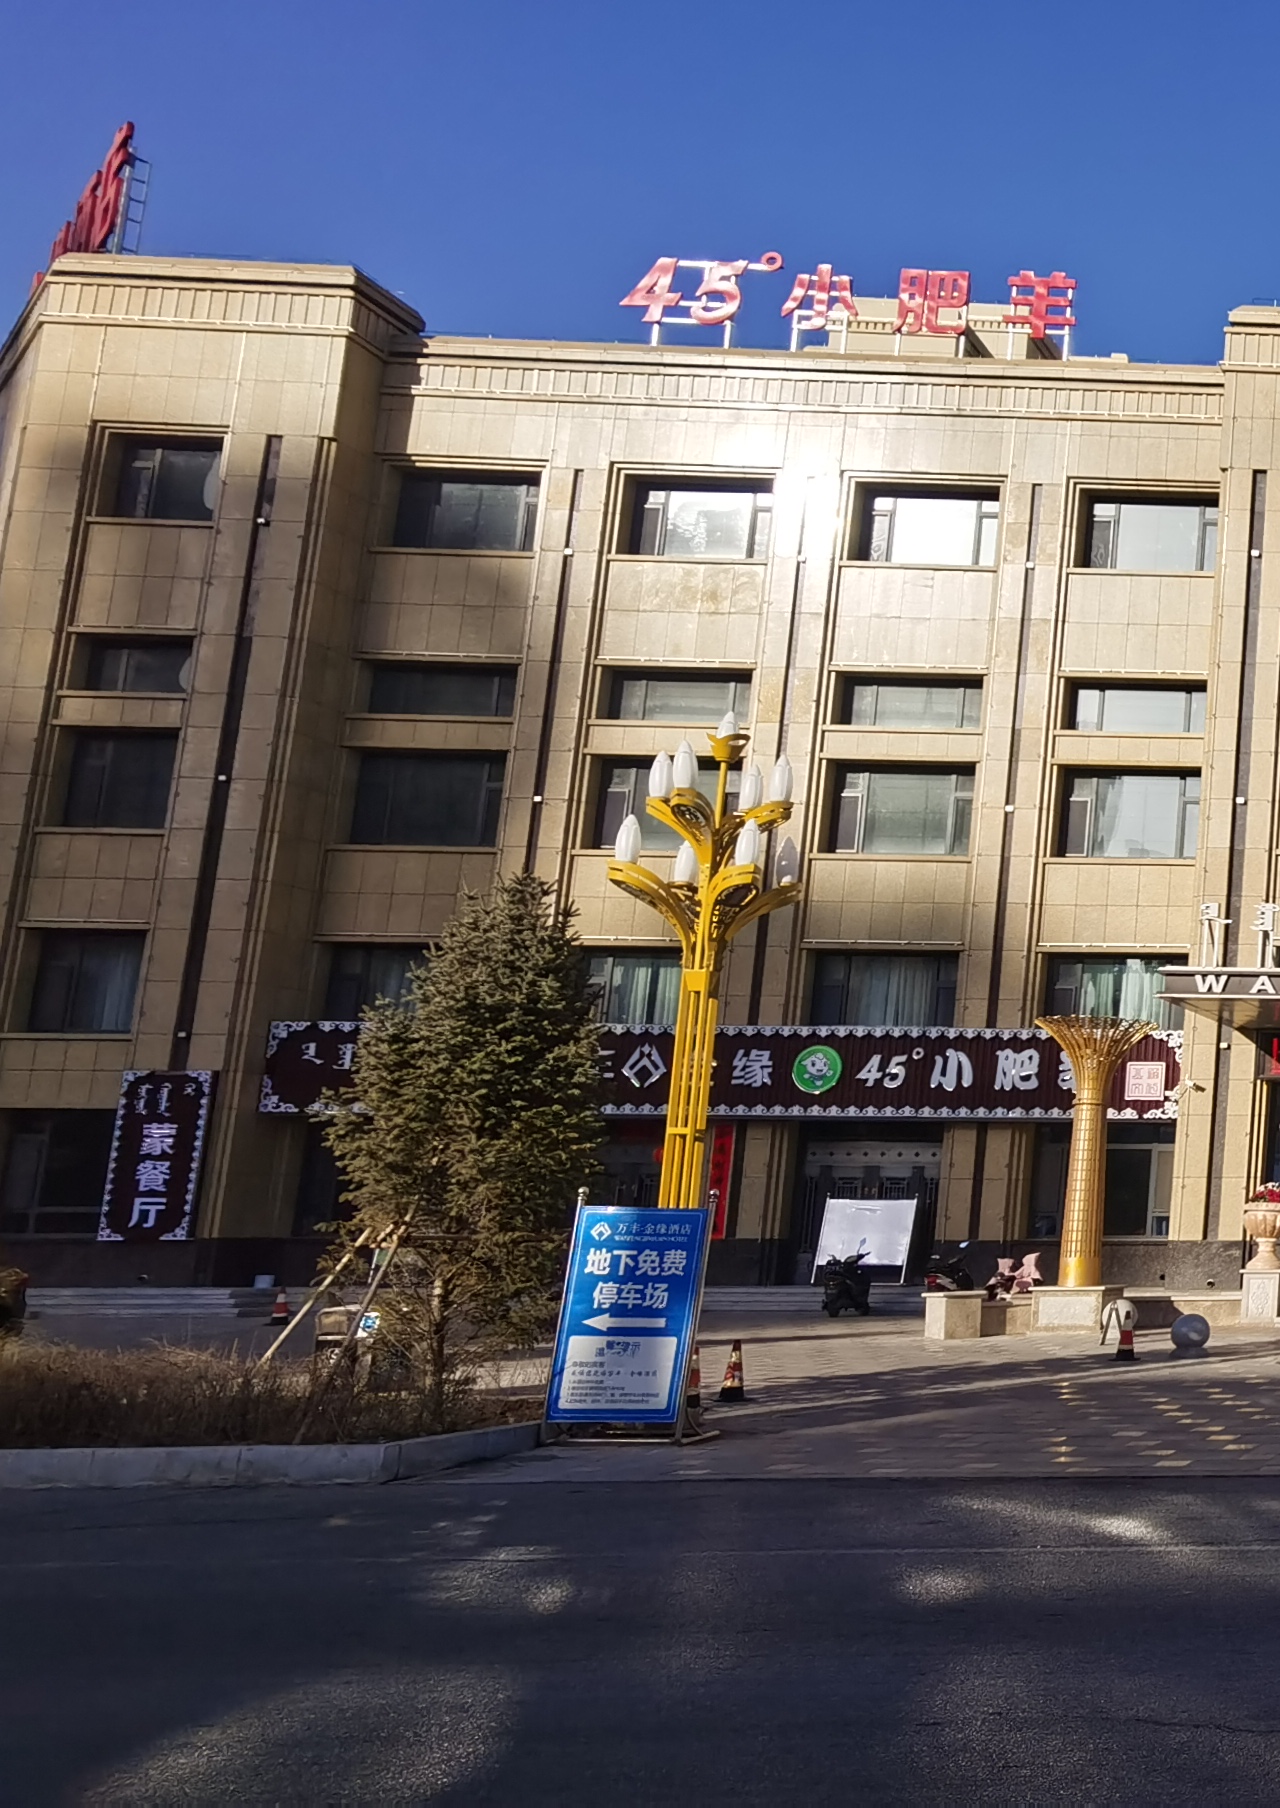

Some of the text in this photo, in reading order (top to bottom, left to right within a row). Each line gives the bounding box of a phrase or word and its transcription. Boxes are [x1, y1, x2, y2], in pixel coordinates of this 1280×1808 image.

[128, 1122, 178, 1229] 蒙餐厅
[584, 1247, 688, 1277] 地下免费
[592, 1281, 669, 1310] 停车场
